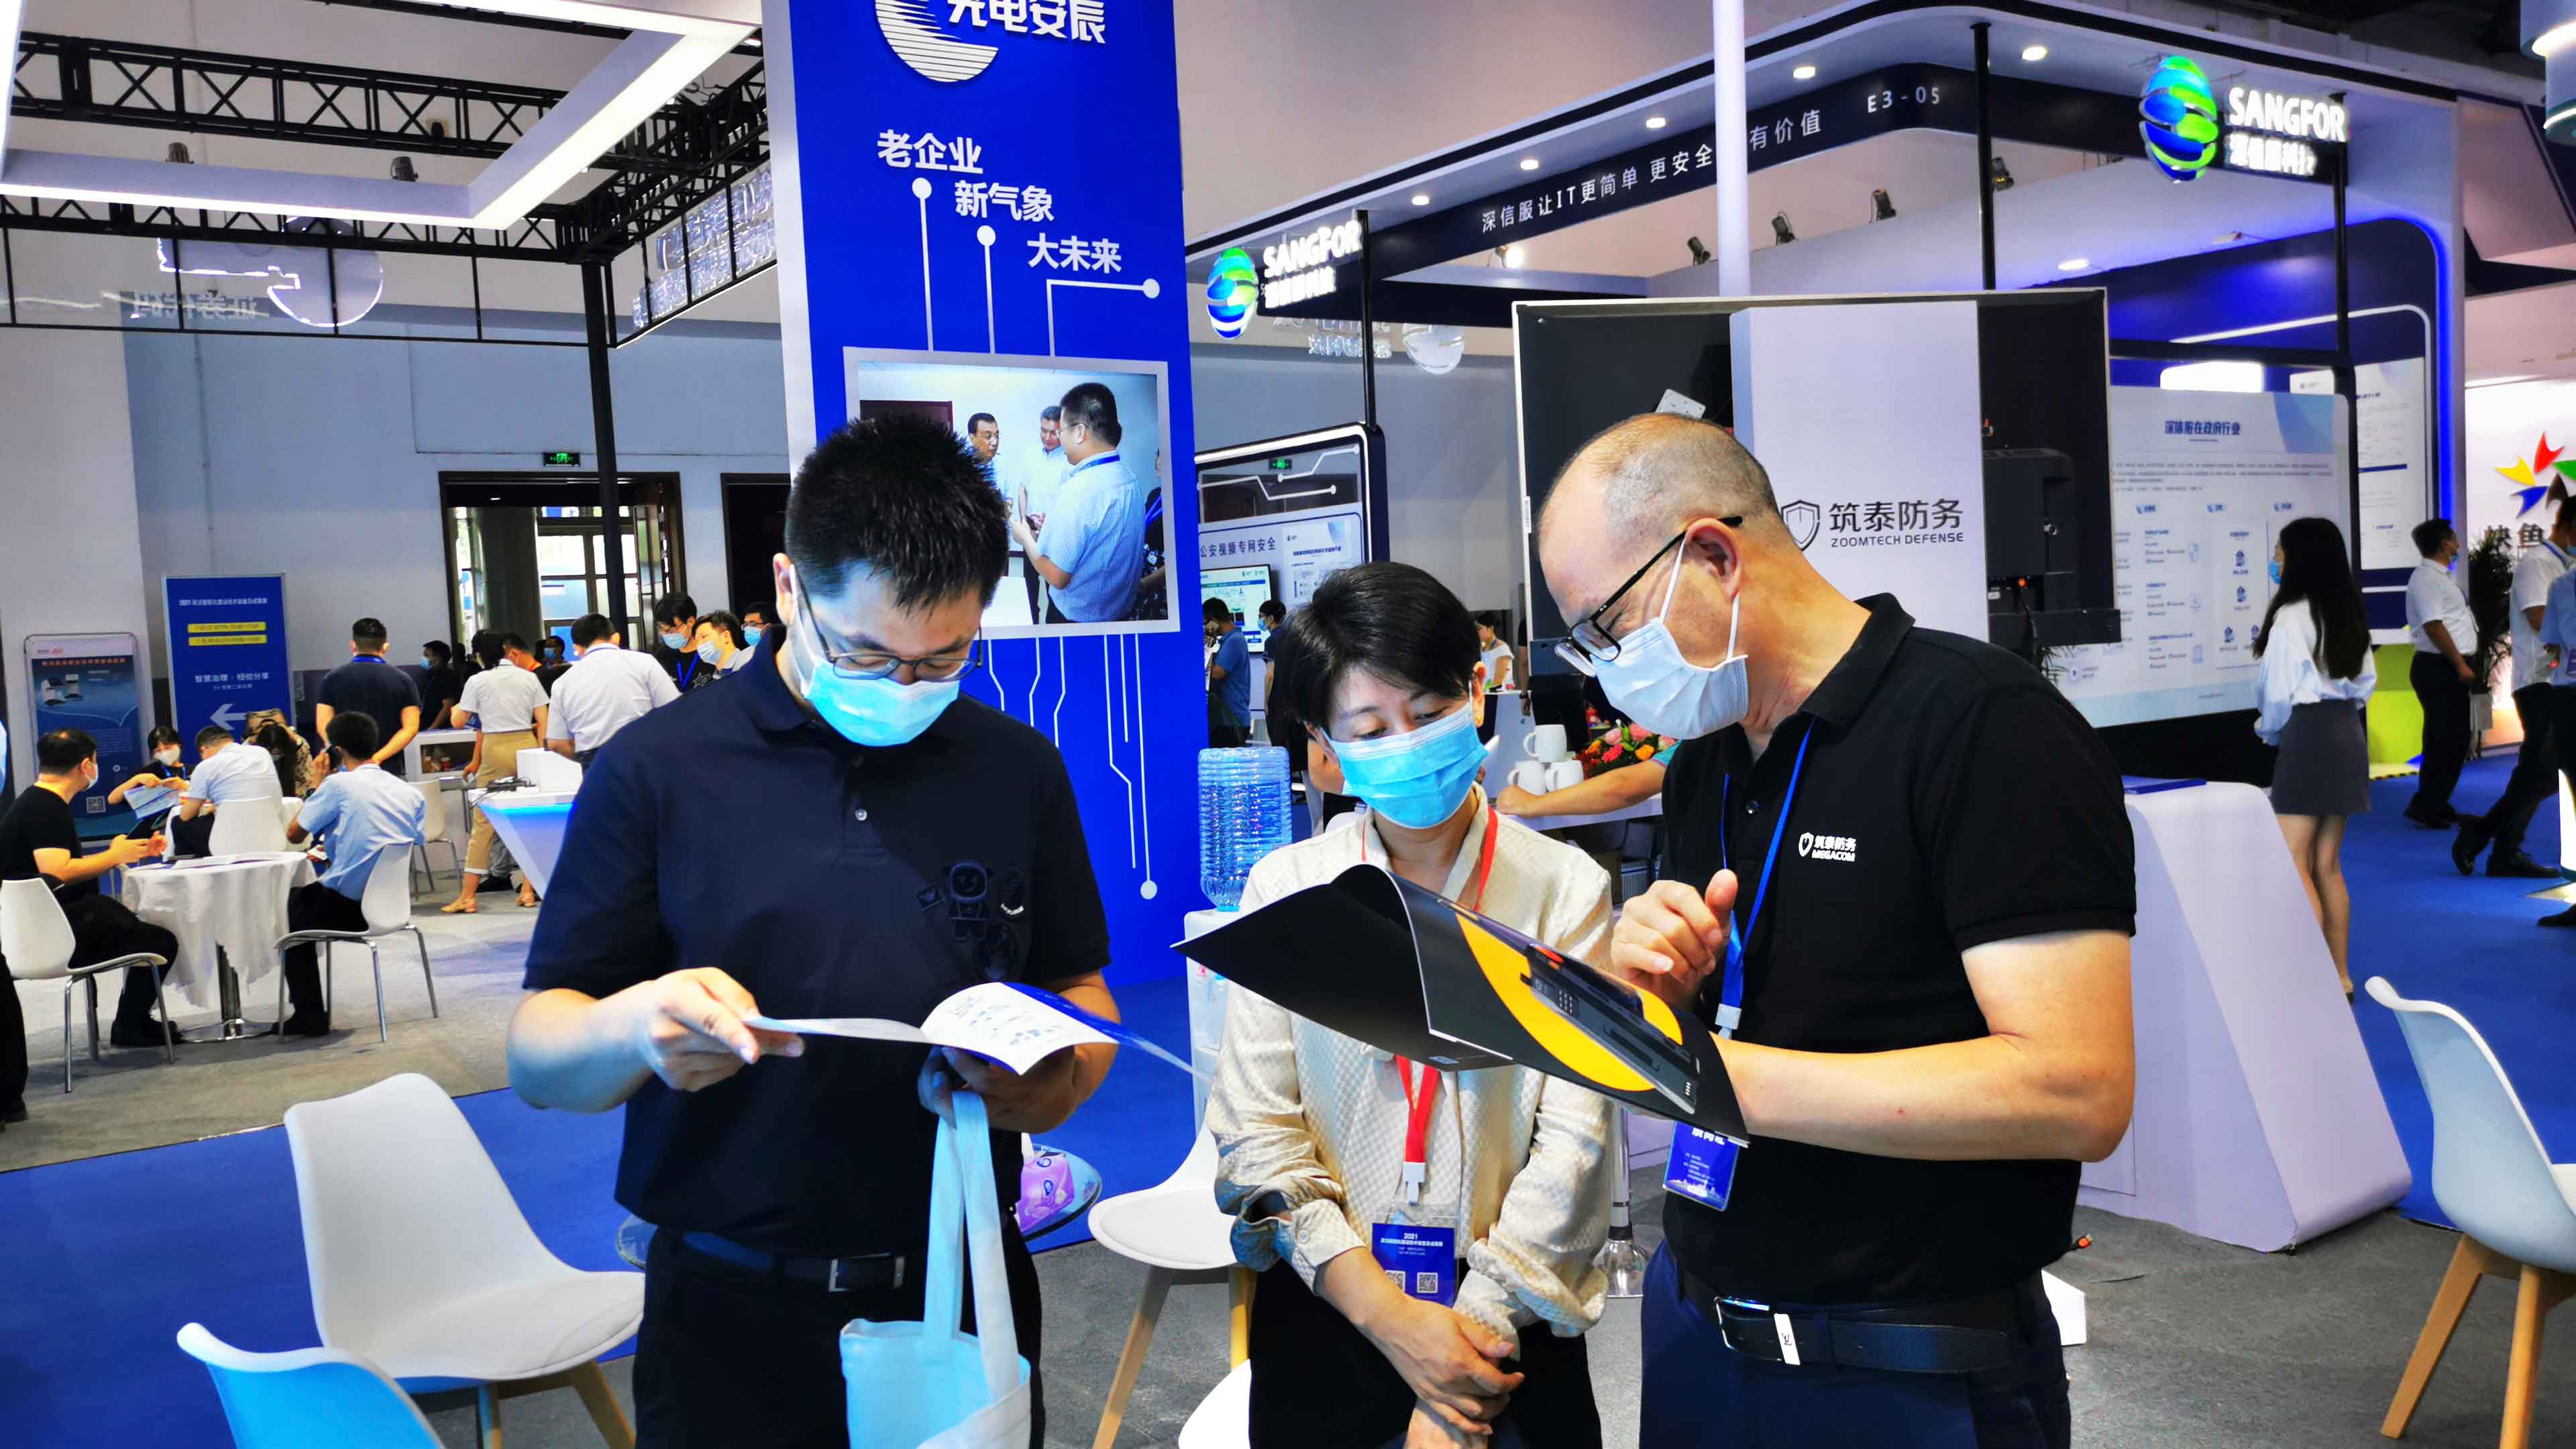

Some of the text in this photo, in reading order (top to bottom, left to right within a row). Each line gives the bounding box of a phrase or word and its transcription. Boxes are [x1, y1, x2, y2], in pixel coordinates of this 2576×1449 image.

[1867, 86, 1941, 113] E3-05
[2229, 87, 2347, 142] SANGFOR
[877, 129, 984, 174] 老企业
[1481, 109, 1823, 233] 深信服让IT更简单 更安全 有价值
[955, 180, 1055, 223] 新气象
[1027, 232, 1122, 274] 大未来
[1263, 220, 1363, 278] SANGFOR
[1828, 497, 1964, 533] 筑泰防务
[1199, 536, 1277, 558] 公安视频专网安全
[1831, 532, 1964, 548] ZOOMTECH DEFENSE
